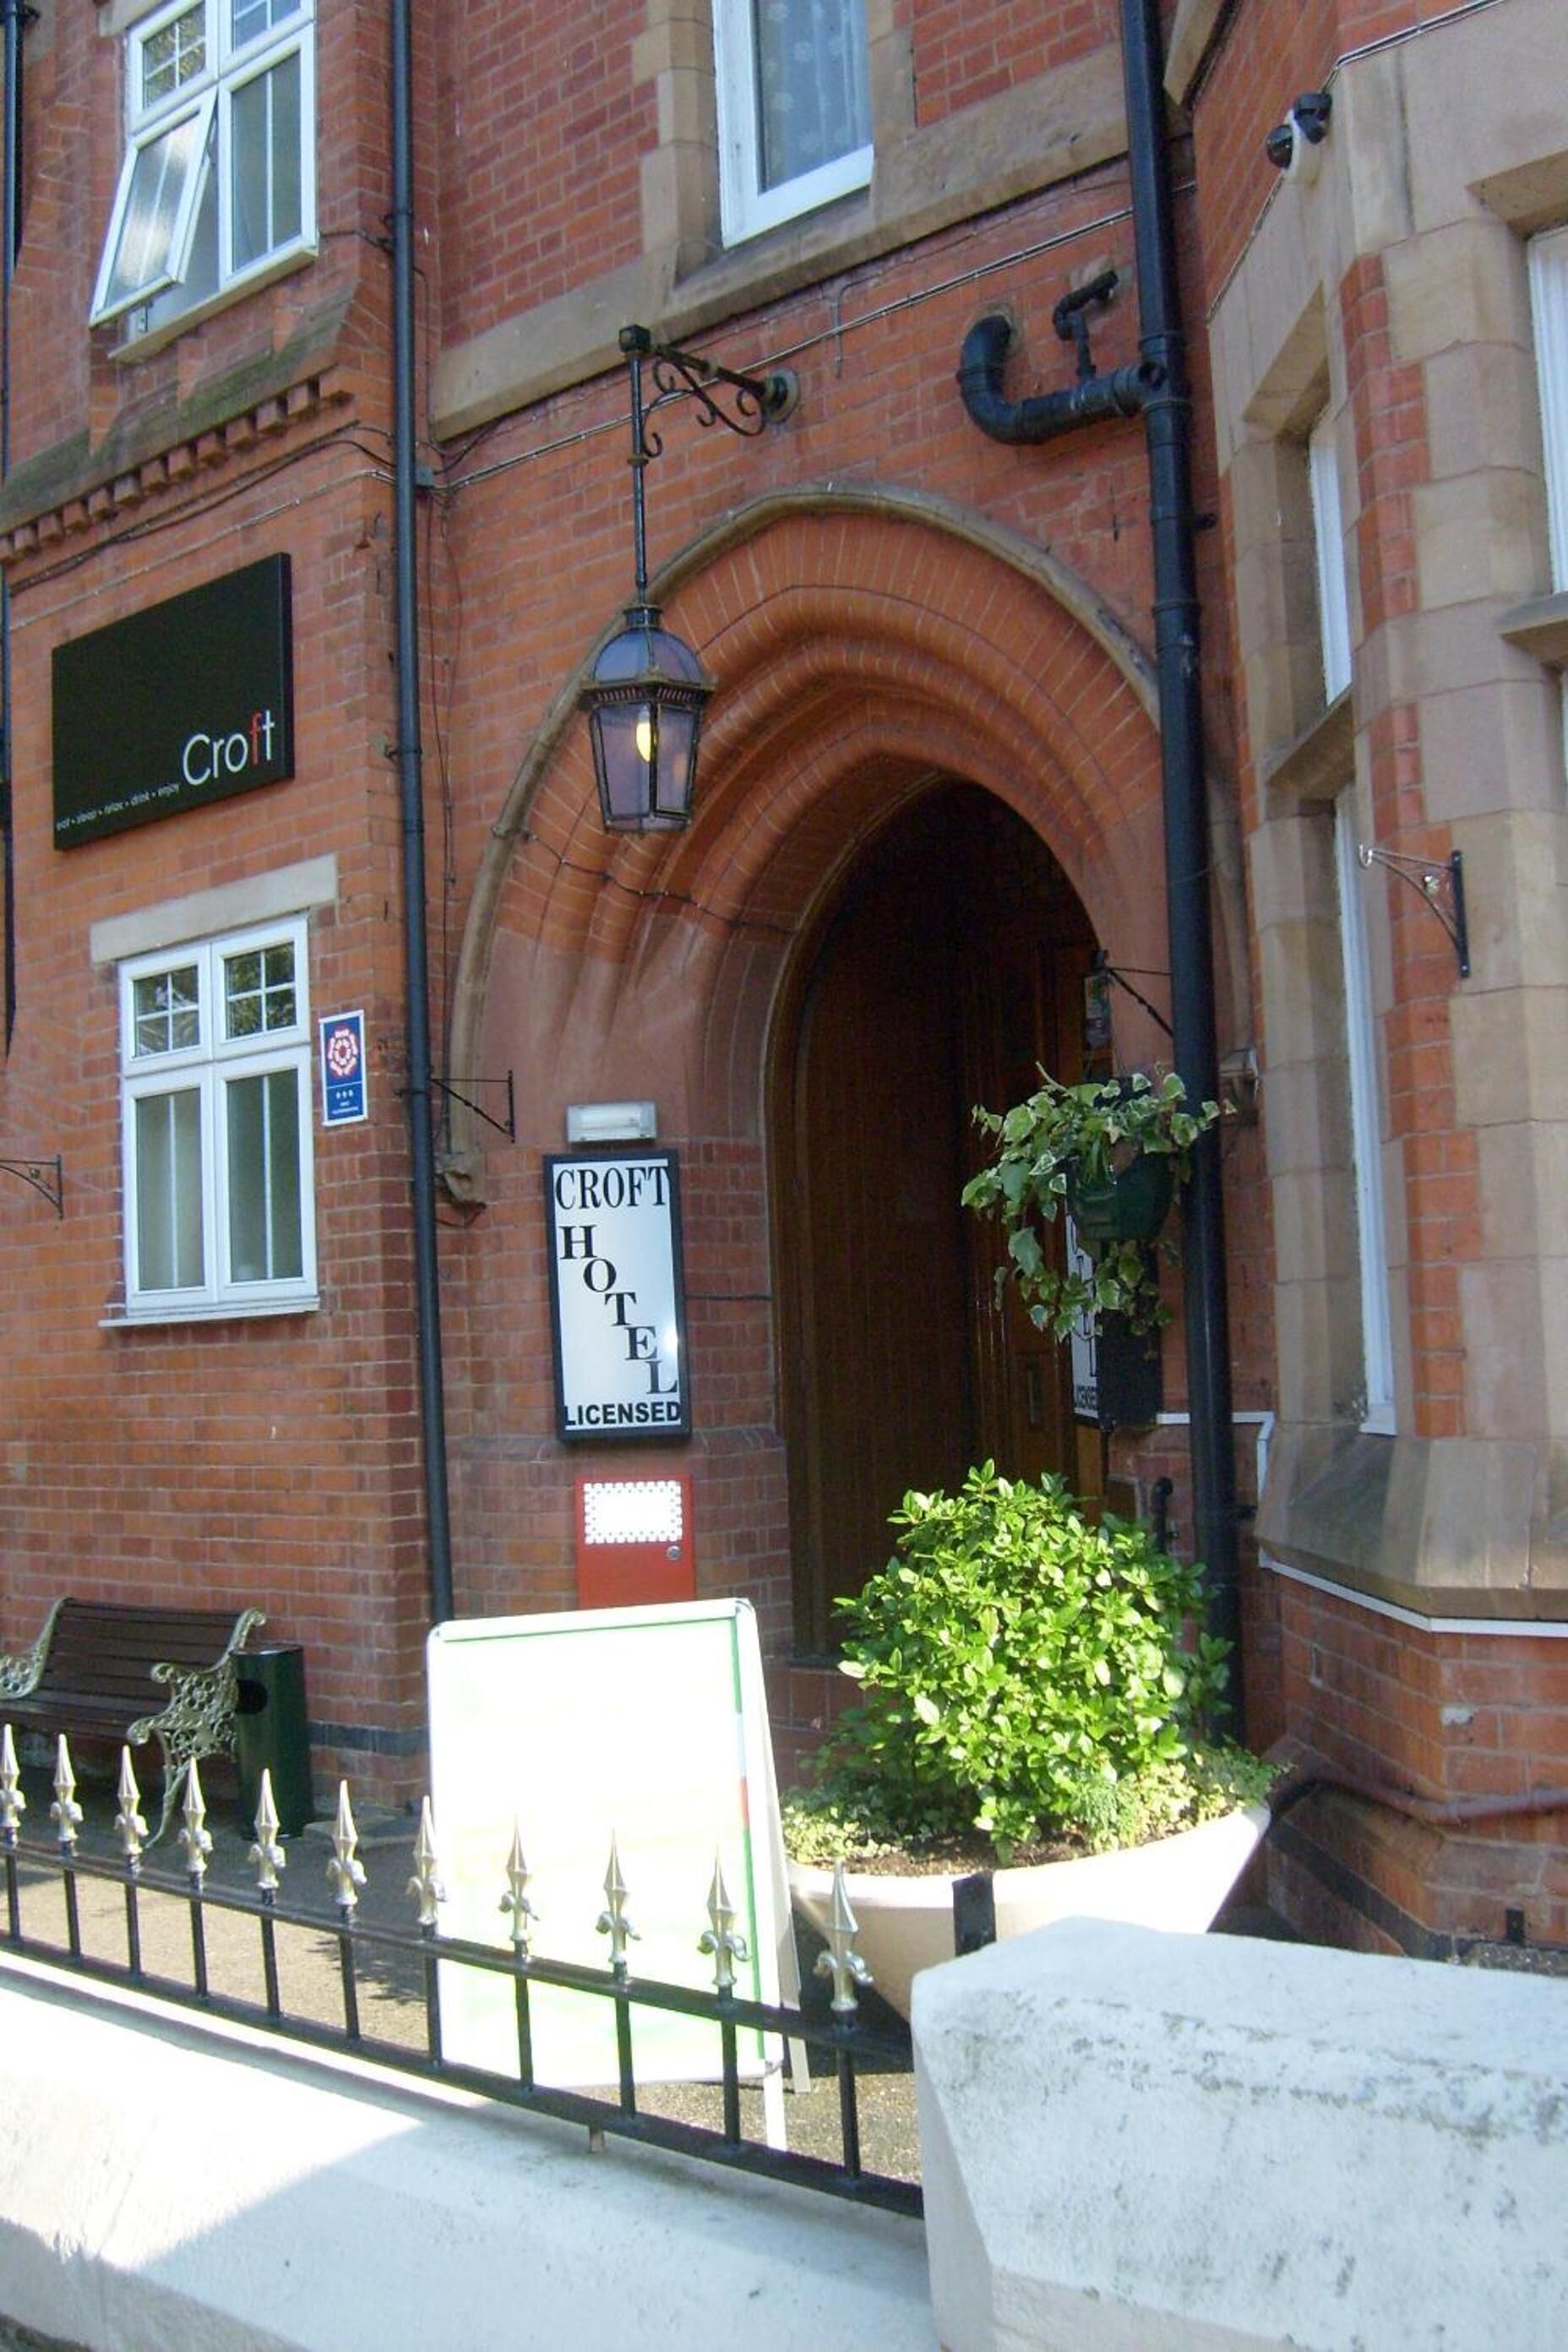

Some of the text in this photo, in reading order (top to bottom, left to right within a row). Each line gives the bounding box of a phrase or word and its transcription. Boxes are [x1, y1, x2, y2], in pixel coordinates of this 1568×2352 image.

[182, 710, 275, 786] Croft
[555, 1166, 668, 1210] CROFT
[559, 1224, 677, 1395] HOTEL
[563, 1401, 681, 1426] LICENSED
